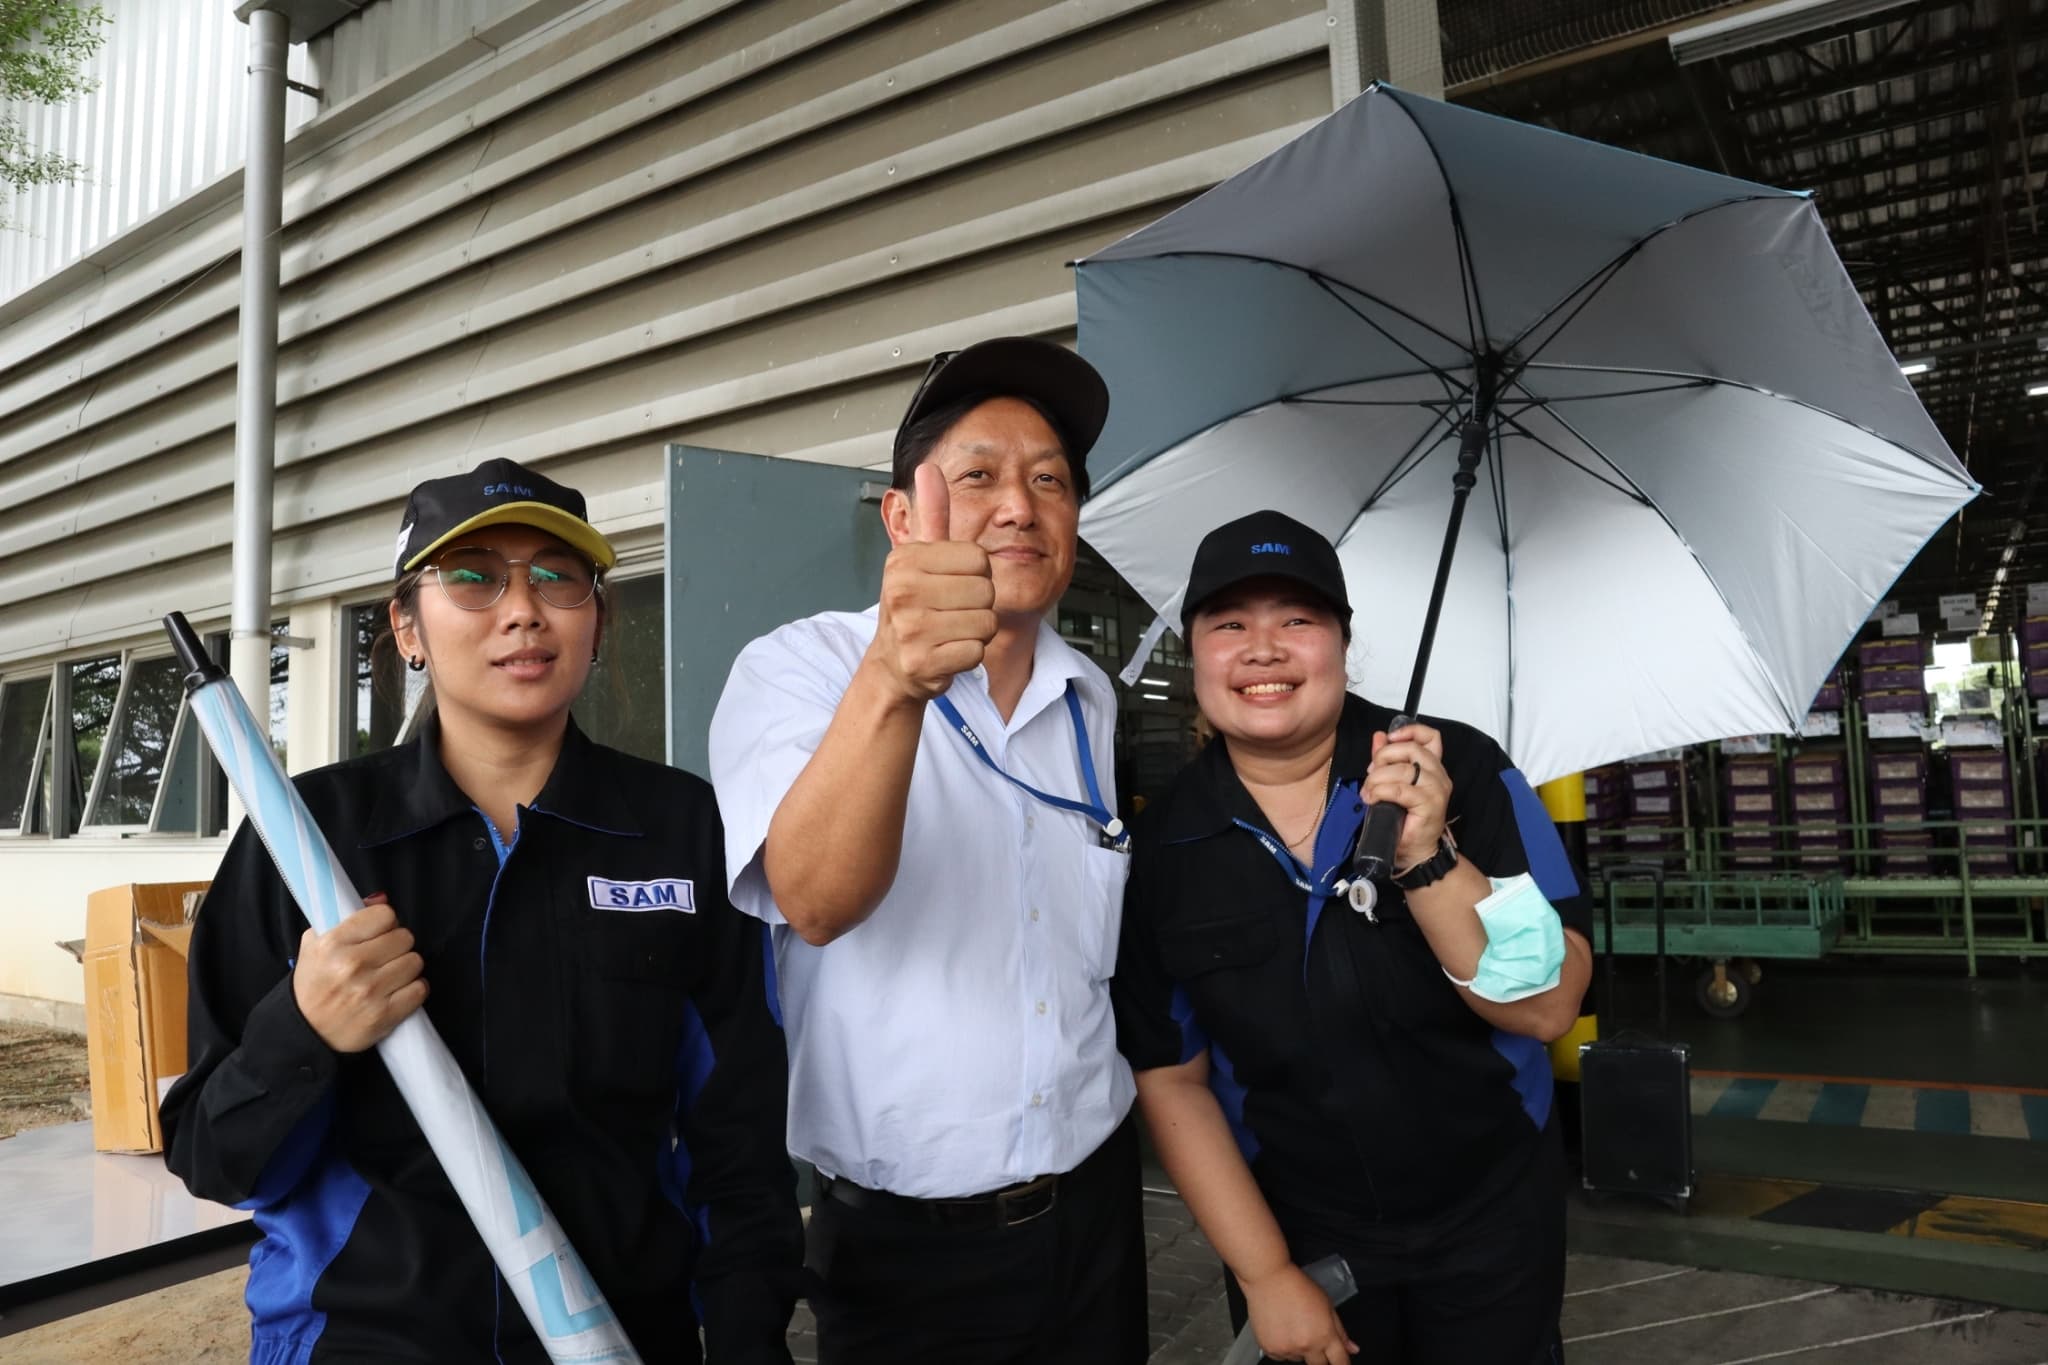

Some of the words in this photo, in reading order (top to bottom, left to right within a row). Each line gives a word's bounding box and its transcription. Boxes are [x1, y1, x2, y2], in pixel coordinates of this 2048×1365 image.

[483, 483, 533, 496] SAM
[1250, 543, 1289, 555] SAM
[960, 725, 978, 746] SAM
[1260, 836, 1277, 854] SAM
[1295, 878, 1312, 892] SAM
[609, 885, 677, 906] SAM
